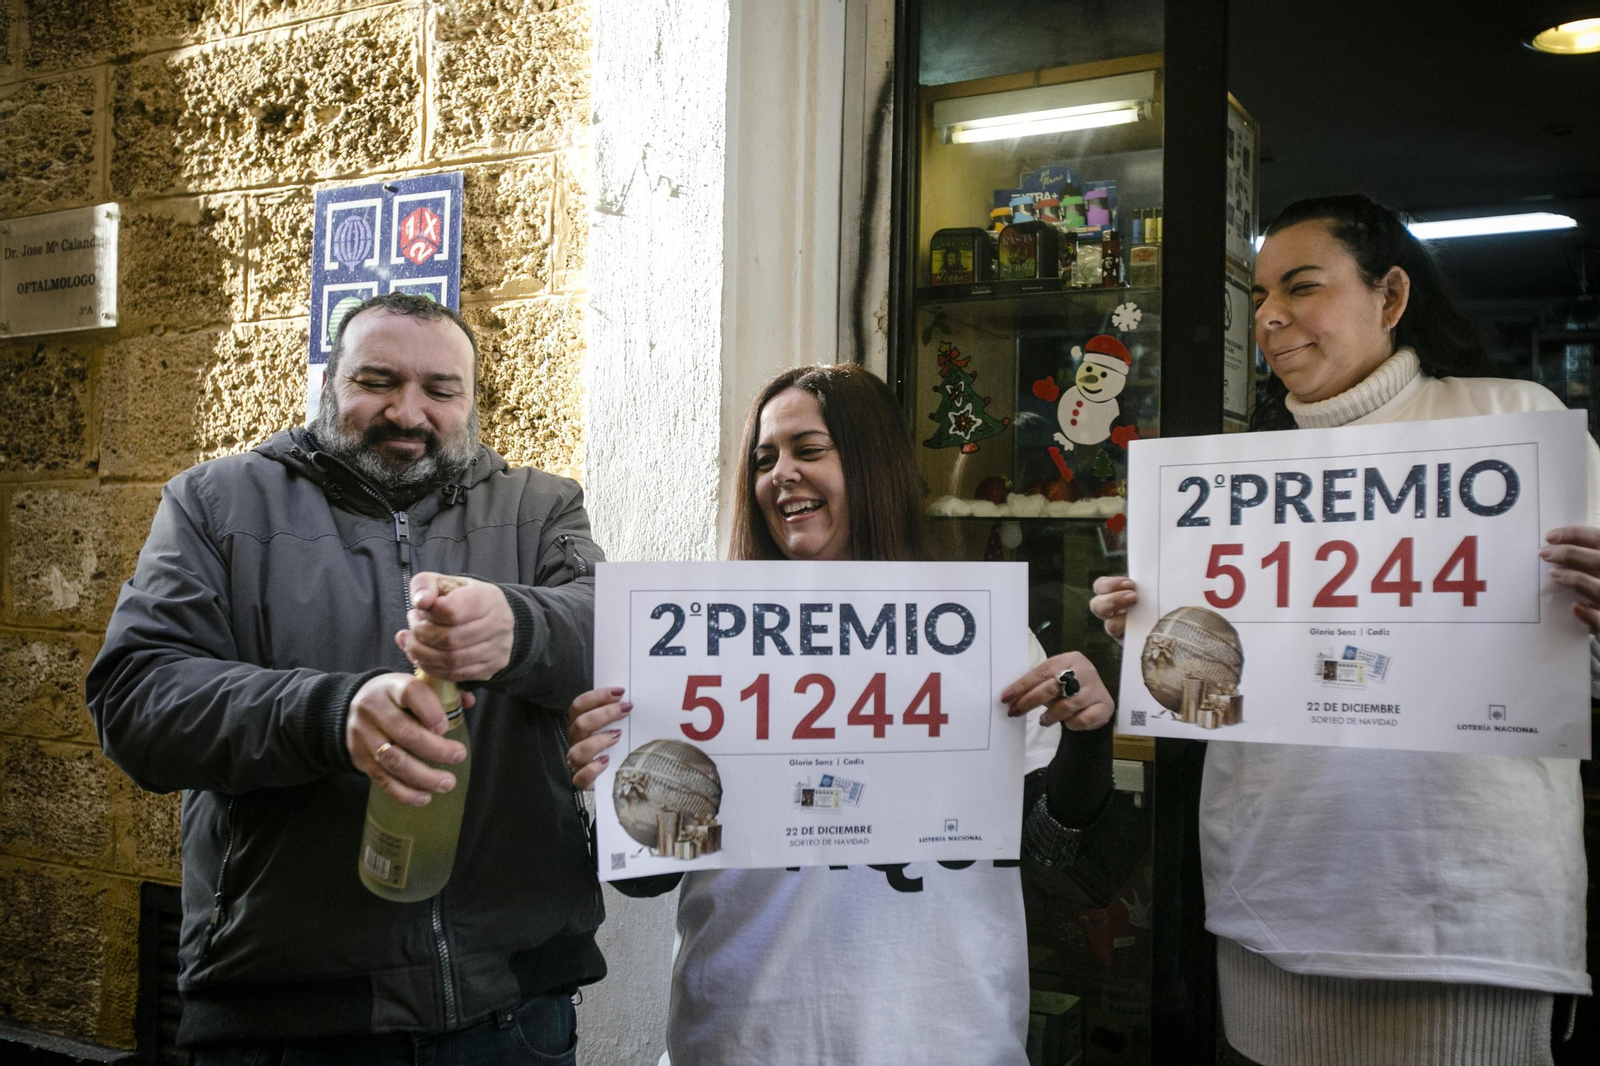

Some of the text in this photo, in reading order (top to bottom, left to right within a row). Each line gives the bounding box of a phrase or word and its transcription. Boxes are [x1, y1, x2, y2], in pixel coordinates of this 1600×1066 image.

[4, 247, 18, 260] Dr.
[21, 244, 43, 257] Jose
[17, 274, 96, 294] OFTALMOLOGO
[1203, 535, 1487, 610] 51244
[1310, 628, 1390, 636] Gloria Sanz Cadiz
[680, 672, 949, 742] 51244
[1307, 702, 1401, 714] 22 DE DICIEMBRE
[1311, 716, 1398, 726] SORTEO DE NAVIDAD
[1494, 725, 1539, 734] NACIONAL
[789, 758, 865, 767] Gloria Sanz Cadiz
[786, 825, 873, 837] 22 DE DICIEMBRE
[790, 839, 820, 848] SORTEO
[834, 838, 870, 846] NAVIDAD
